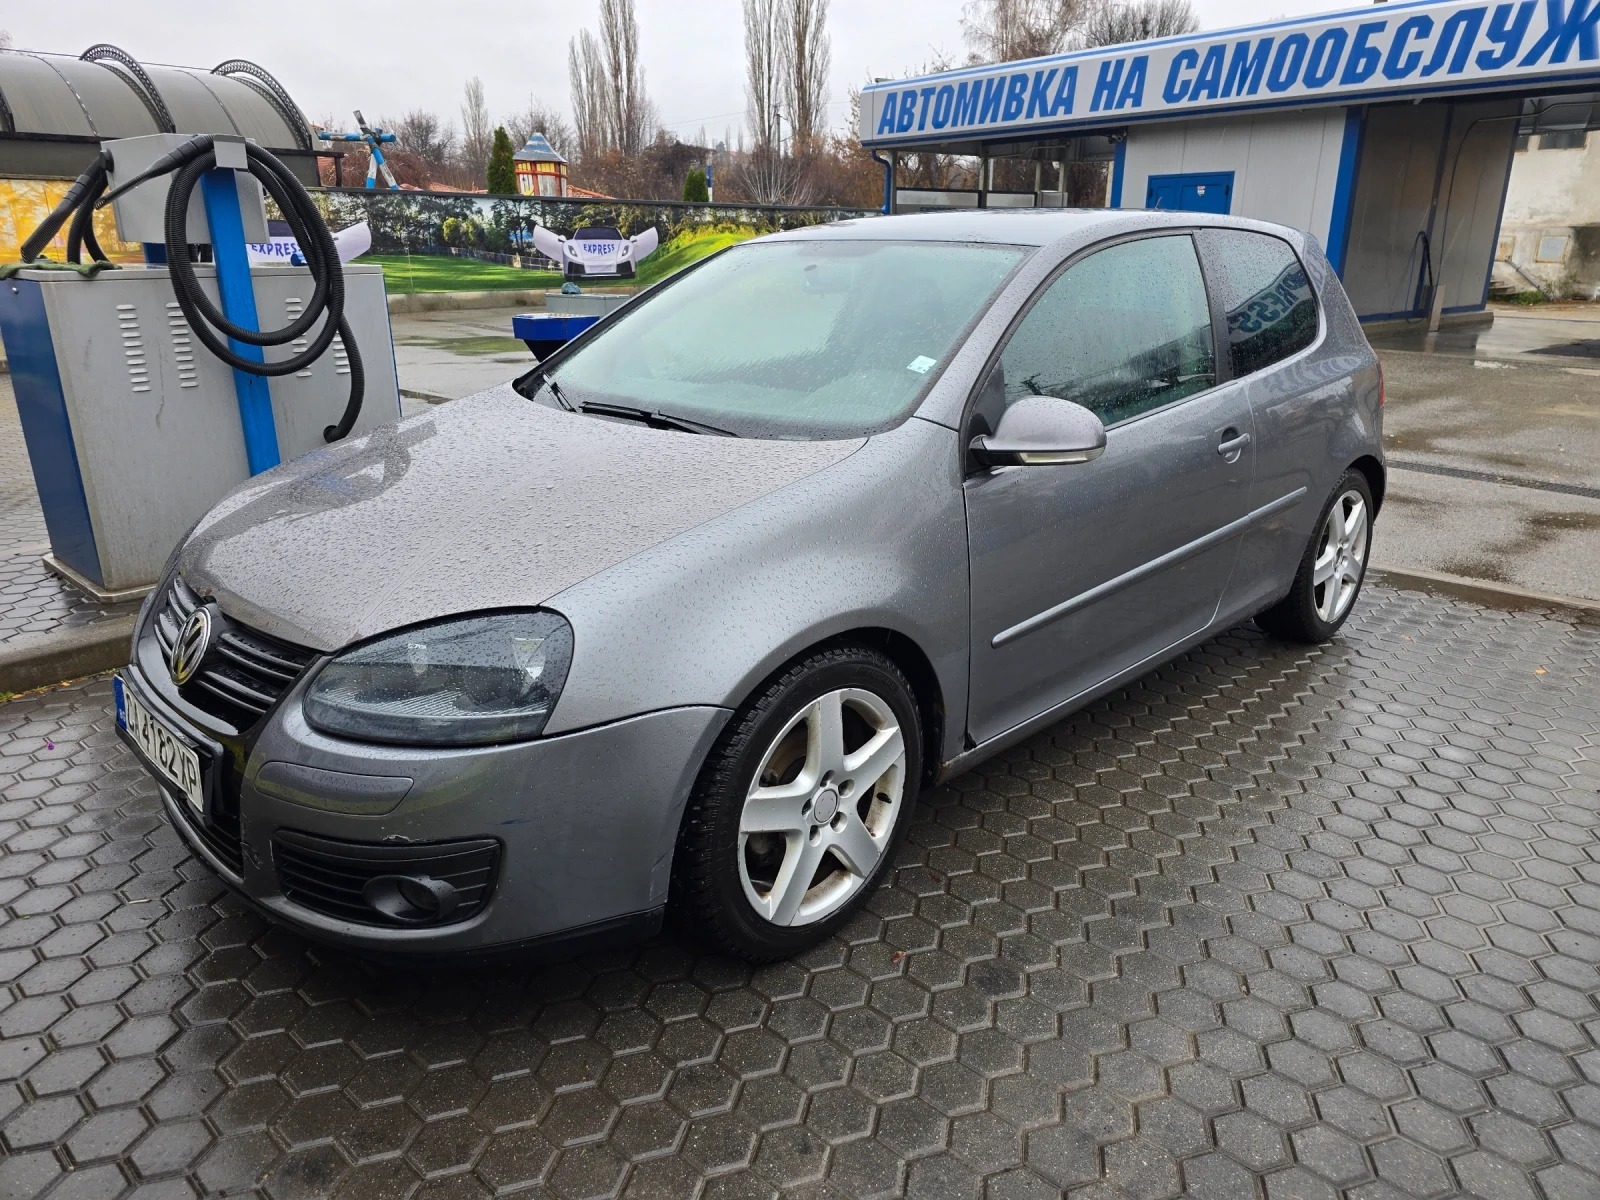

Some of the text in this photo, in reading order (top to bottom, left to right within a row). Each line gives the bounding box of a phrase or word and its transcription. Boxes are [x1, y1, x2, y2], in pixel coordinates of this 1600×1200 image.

[877, 0, 1600, 135] АВТОМИВКА НА САМООБСЛУЖ
[251, 243, 301, 257] EXPRES
[583, 243, 615, 256] EXPRESS
